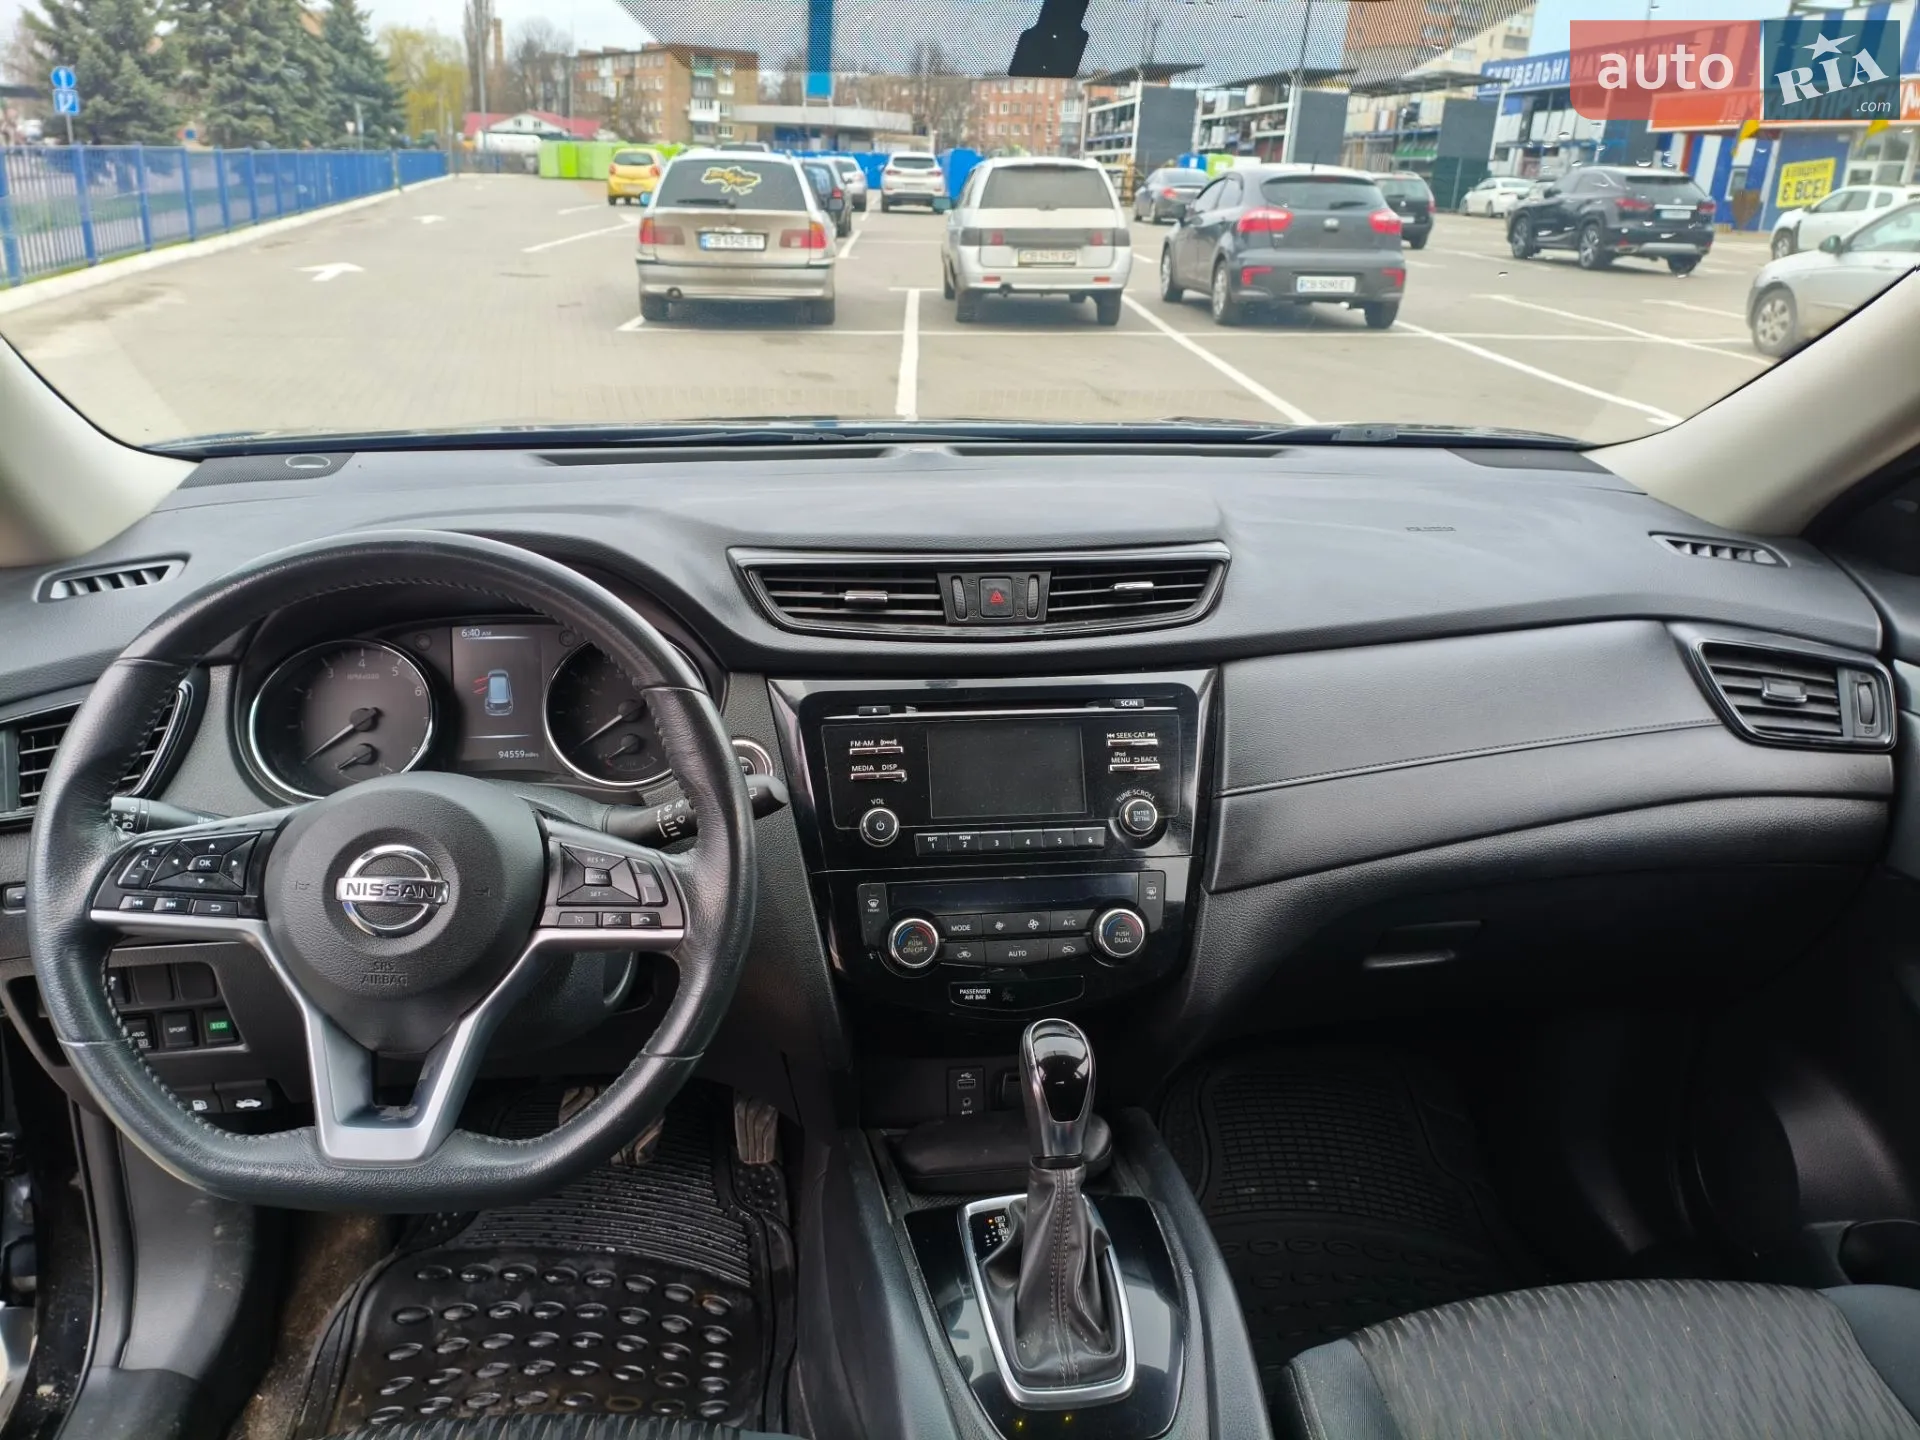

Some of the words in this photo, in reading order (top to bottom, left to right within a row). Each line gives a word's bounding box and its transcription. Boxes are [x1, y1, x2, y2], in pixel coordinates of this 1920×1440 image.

[461, 629, 481, 638] 6:40
[392, 666, 399, 677] 5
[498, 750, 525, 759] 94559
[882, 763, 898, 771] DISP
[1087, 836, 1093, 844] 6
[199, 859, 212, 867] OK
[346, 882, 437, 899] NISSAN
[1063, 919, 1077, 927] A/C
[951, 924, 972, 932] MODE
[373, 961, 396, 971] SRS
[360, 974, 408, 987] AIRBAG
[168, 1026, 188, 1034] SPORT
